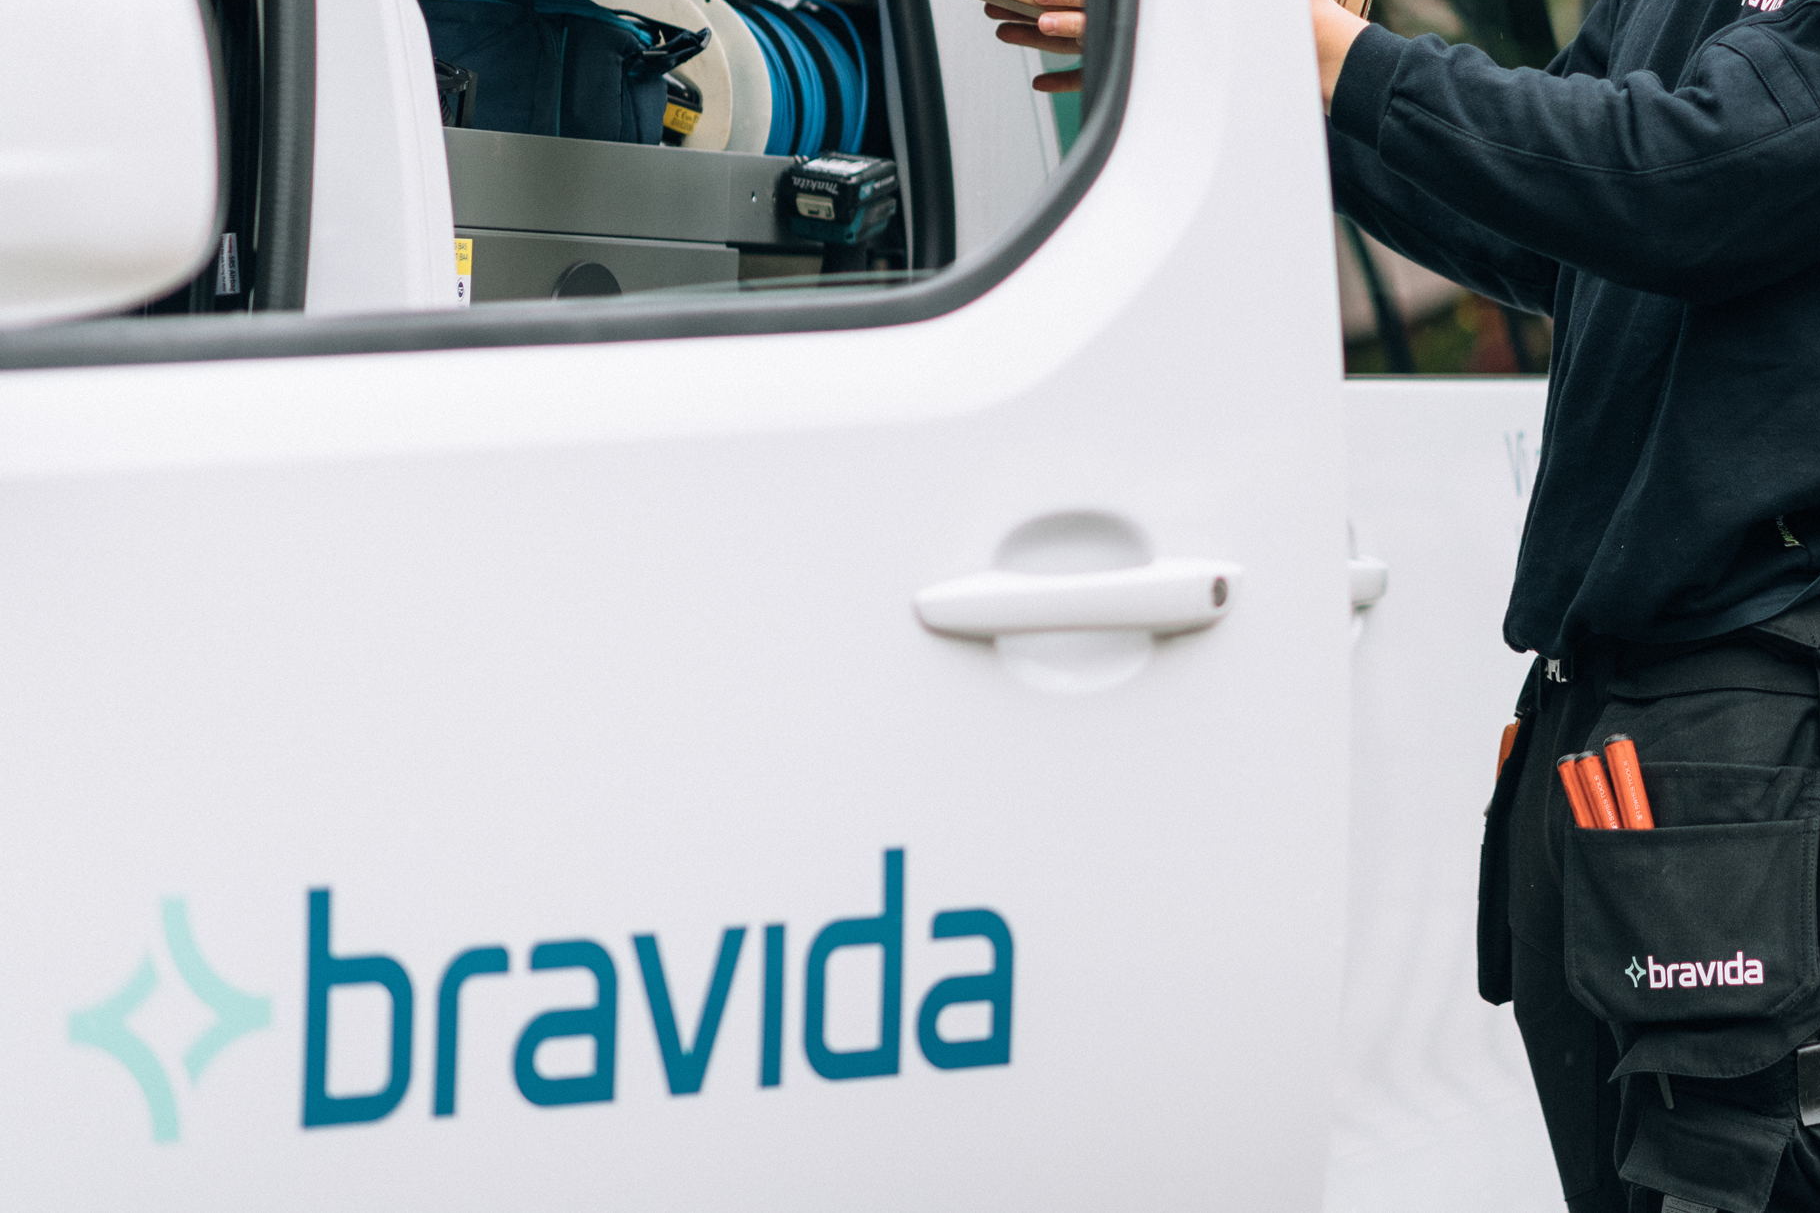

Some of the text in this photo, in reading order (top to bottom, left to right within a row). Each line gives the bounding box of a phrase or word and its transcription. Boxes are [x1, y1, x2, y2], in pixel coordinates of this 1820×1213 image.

[1594, 774, 1605, 799] TOOLS
[1603, 799, 1614, 821] SWISS
[1647, 950, 1764, 989] bravida
[301, 846, 1014, 1130] bravida
